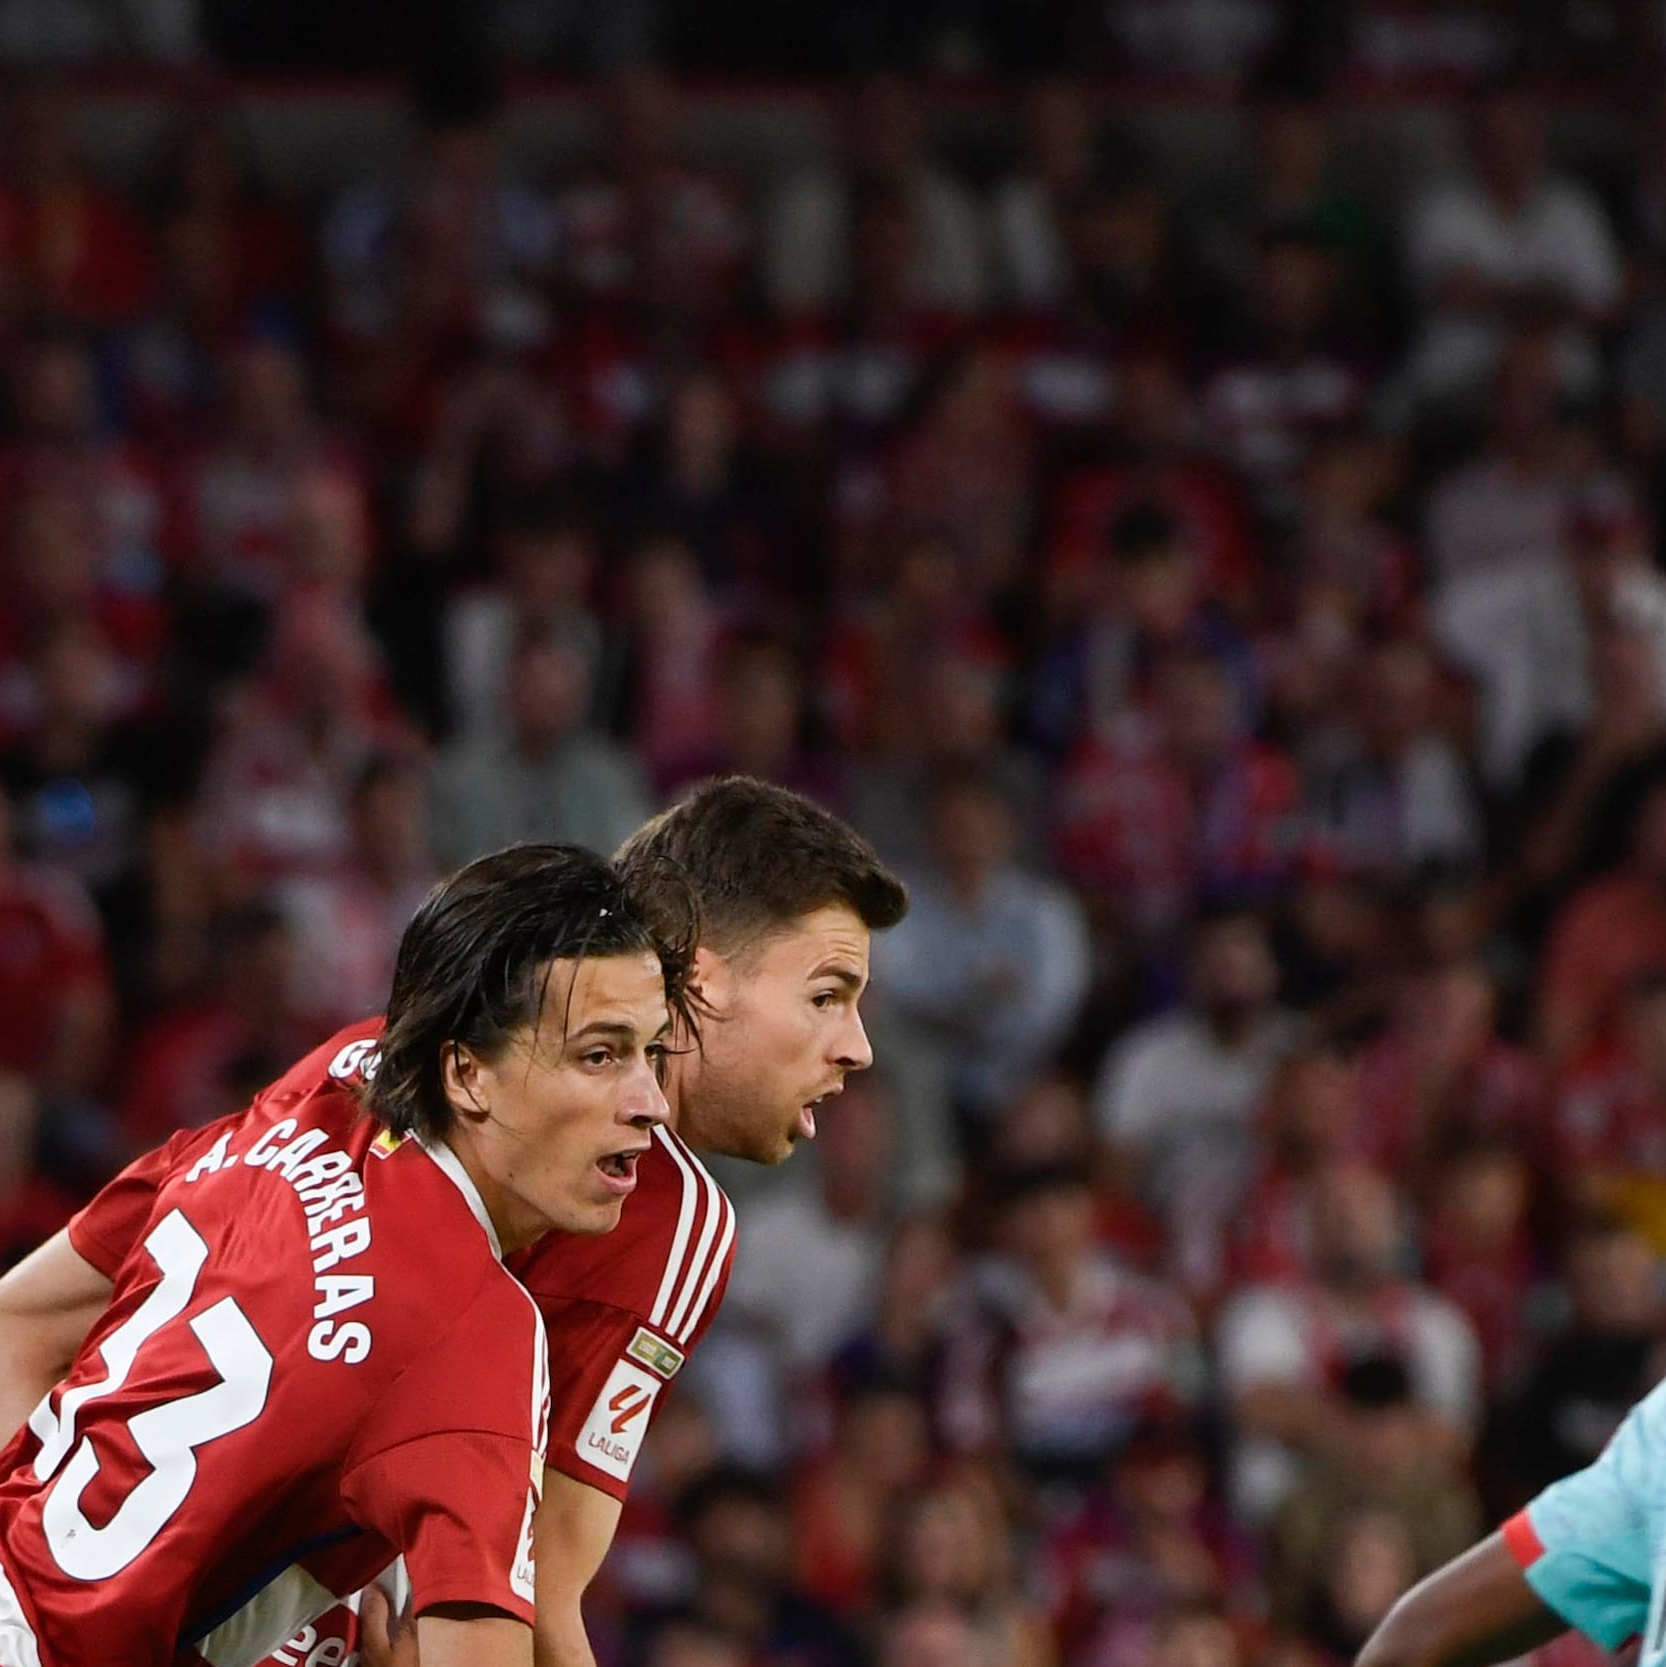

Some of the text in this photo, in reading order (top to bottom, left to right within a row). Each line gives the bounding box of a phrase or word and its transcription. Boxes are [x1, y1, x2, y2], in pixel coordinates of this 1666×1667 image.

[184, 1117, 375, 1365] A. CARRERAS
[587, 1431, 631, 1465] LALIGA
